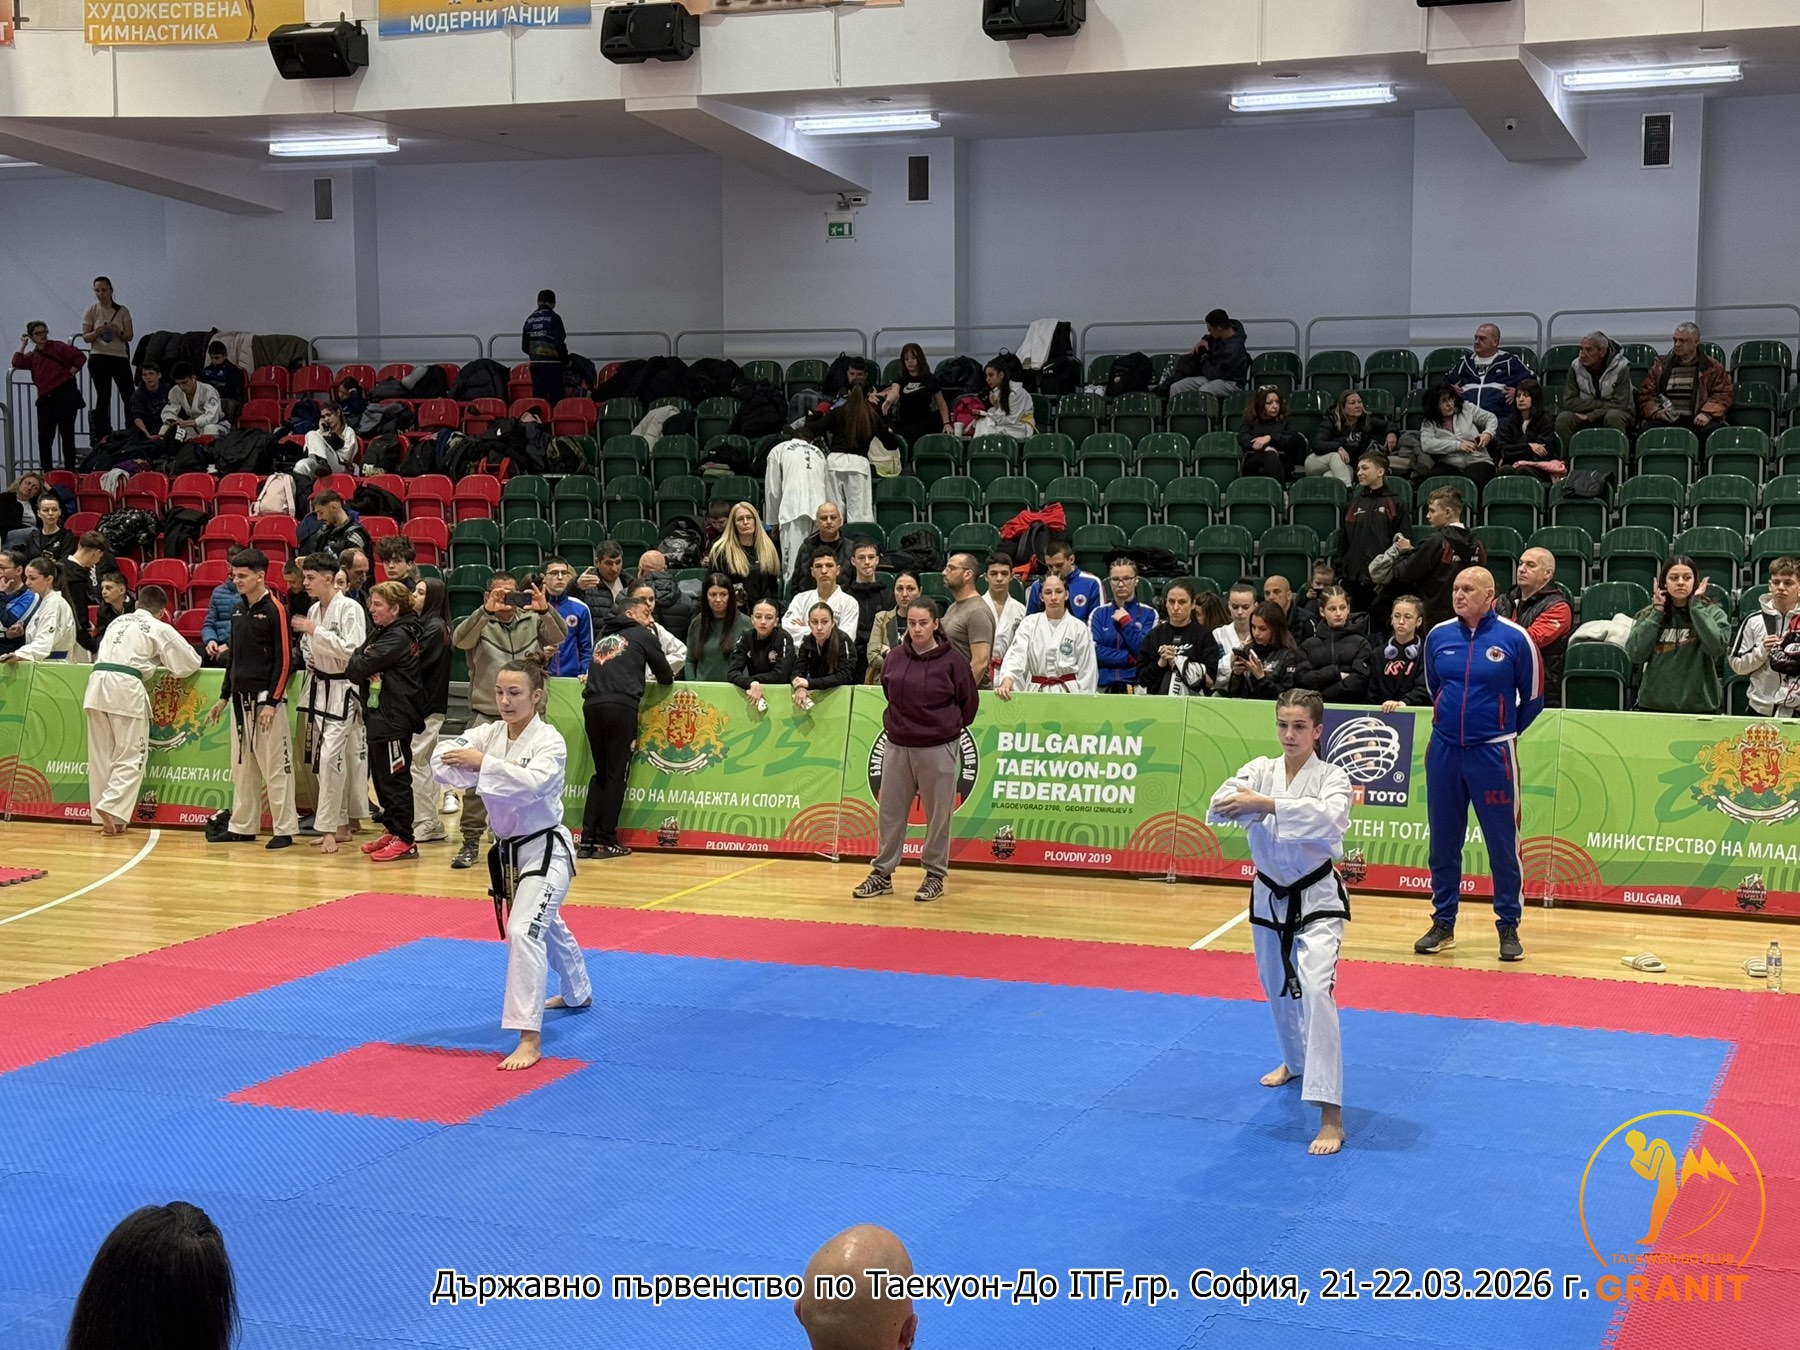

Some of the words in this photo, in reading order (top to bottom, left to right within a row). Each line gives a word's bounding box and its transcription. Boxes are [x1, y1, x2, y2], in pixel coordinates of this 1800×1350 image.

[87, 1, 243, 21] ХУДОЖЕСТВЕНА
[410, 9, 497, 33] МОДЕРНИ
[89, 24, 218, 41] ГИМНАСТИКА
[997, 731, 1143, 756] BULGARIAN
[960, 728, 977, 780] АЕКУОН-ДО
[149, 765, 210, 783] МЛАДЕЖТА
[211, 768, 221, 781] И
[996, 758, 1138, 780] TAEKWON-DO
[648, 788, 665, 802] НА
[667, 789, 738, 809] МЛАДЕЖТА
[740, 792, 751, 807] И
[752, 793, 800, 809] СПОРТА
[992, 780, 1136, 804] FEDERATION
[1368, 790, 1408, 803] TOTO
[64, 807, 91, 818] BULGA
[991, 801, 1043, 811] BLAGOEVGRAD
[1064, 804, 1092, 813] GEORGI
[705, 841, 745, 851] PLOVDIV
[746, 843, 769, 852] 2019
[1586, 831, 1716, 855] МИНИСТЕРСТВО
[1721, 840, 1744, 857] НА
[1044, 850, 1087, 862] PLOVDIV
[1087, 852, 1112, 864] 2019
[1623, 891, 1682, 906] BULGARIA
